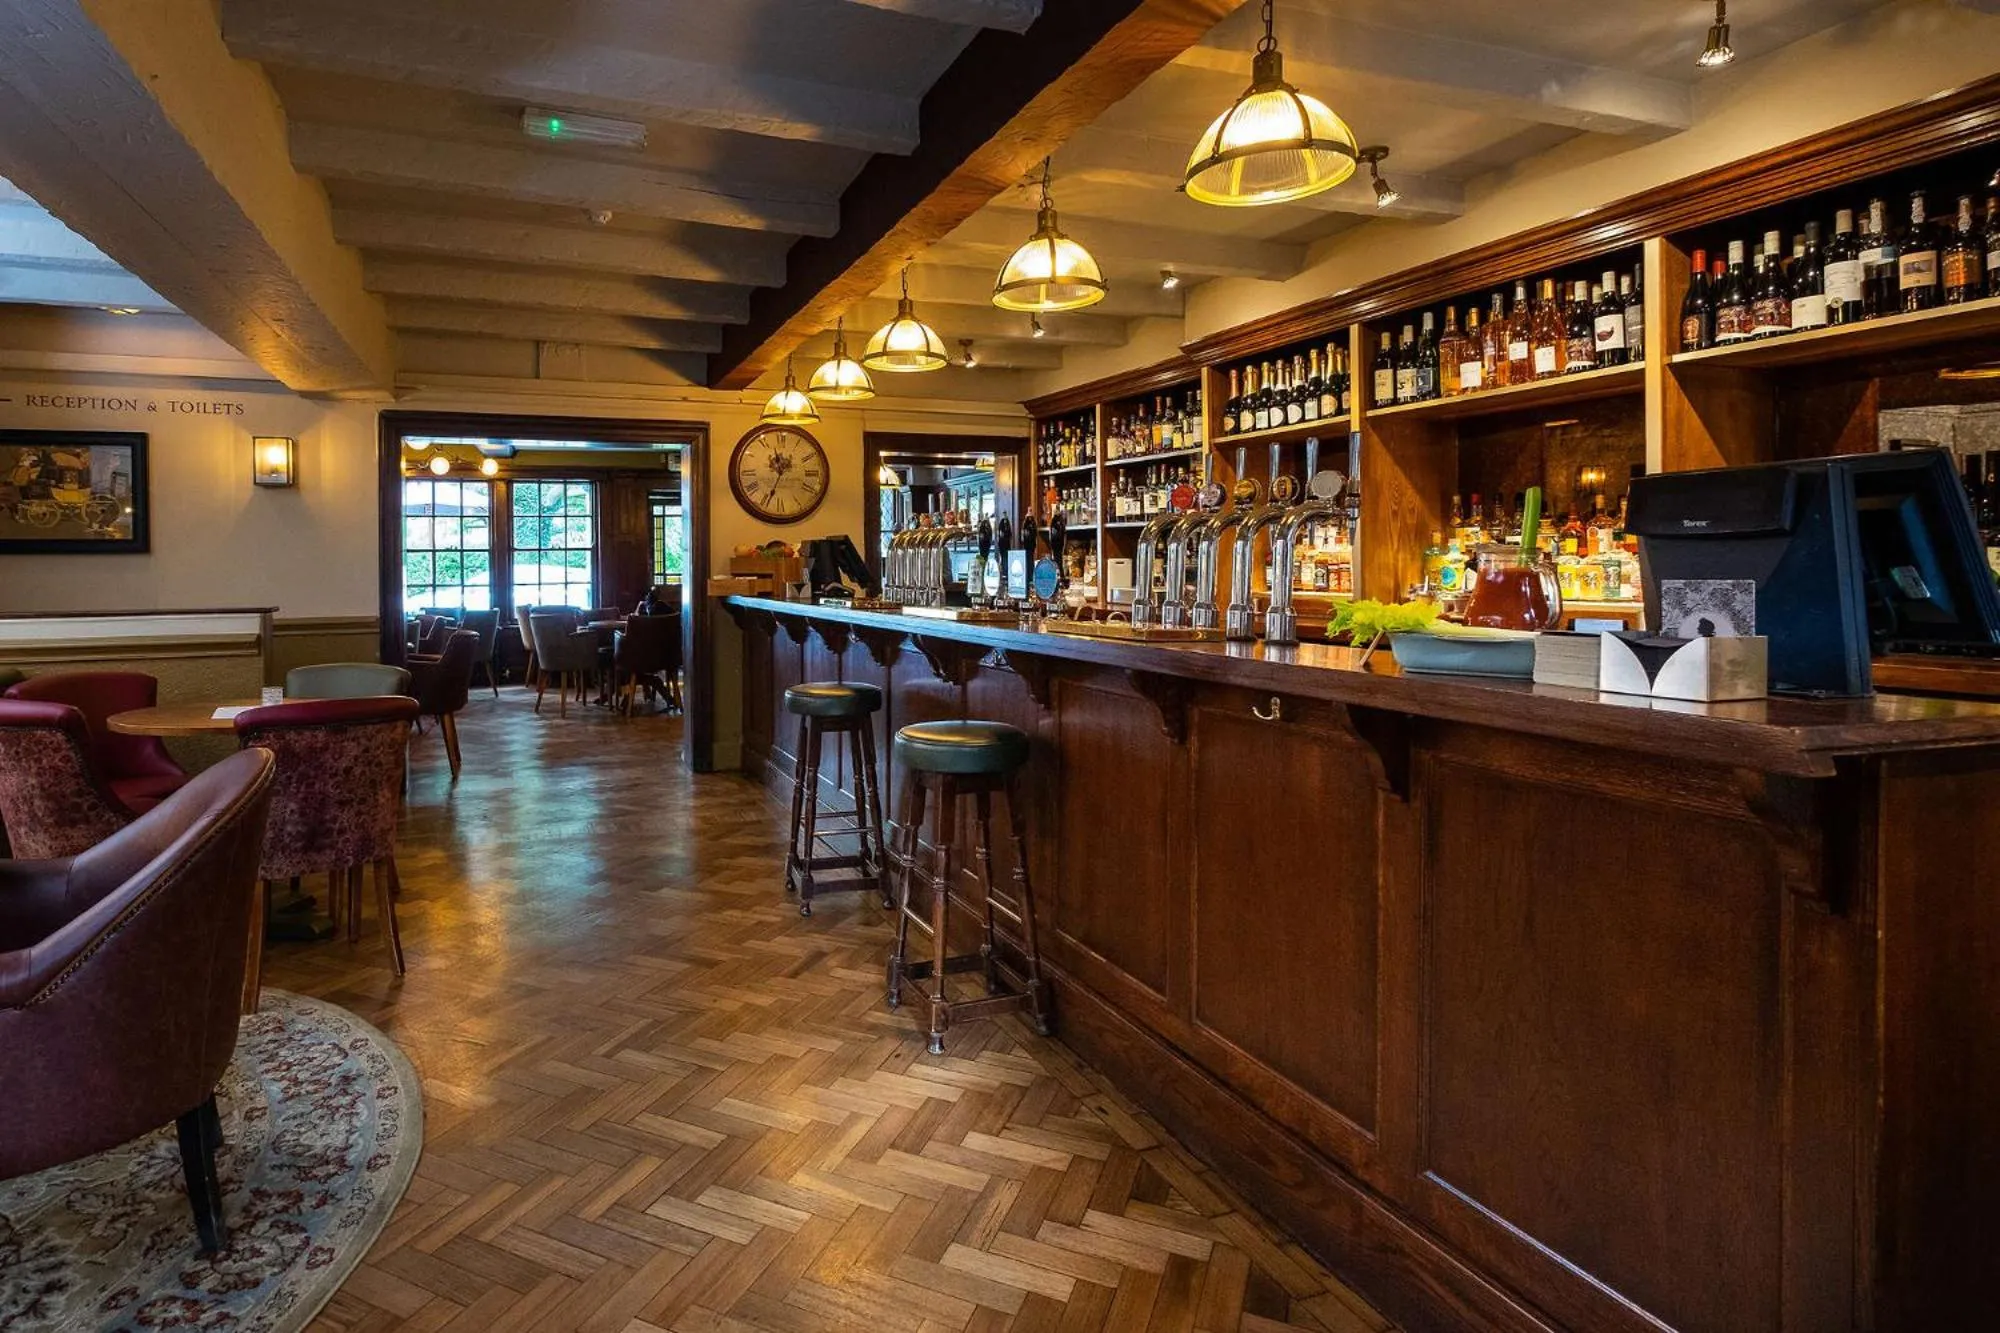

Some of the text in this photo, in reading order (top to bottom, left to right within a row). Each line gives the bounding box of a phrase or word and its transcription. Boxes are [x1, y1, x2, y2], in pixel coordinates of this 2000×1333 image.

[26, 394, 244, 415] RECEPTION & TOILETS
